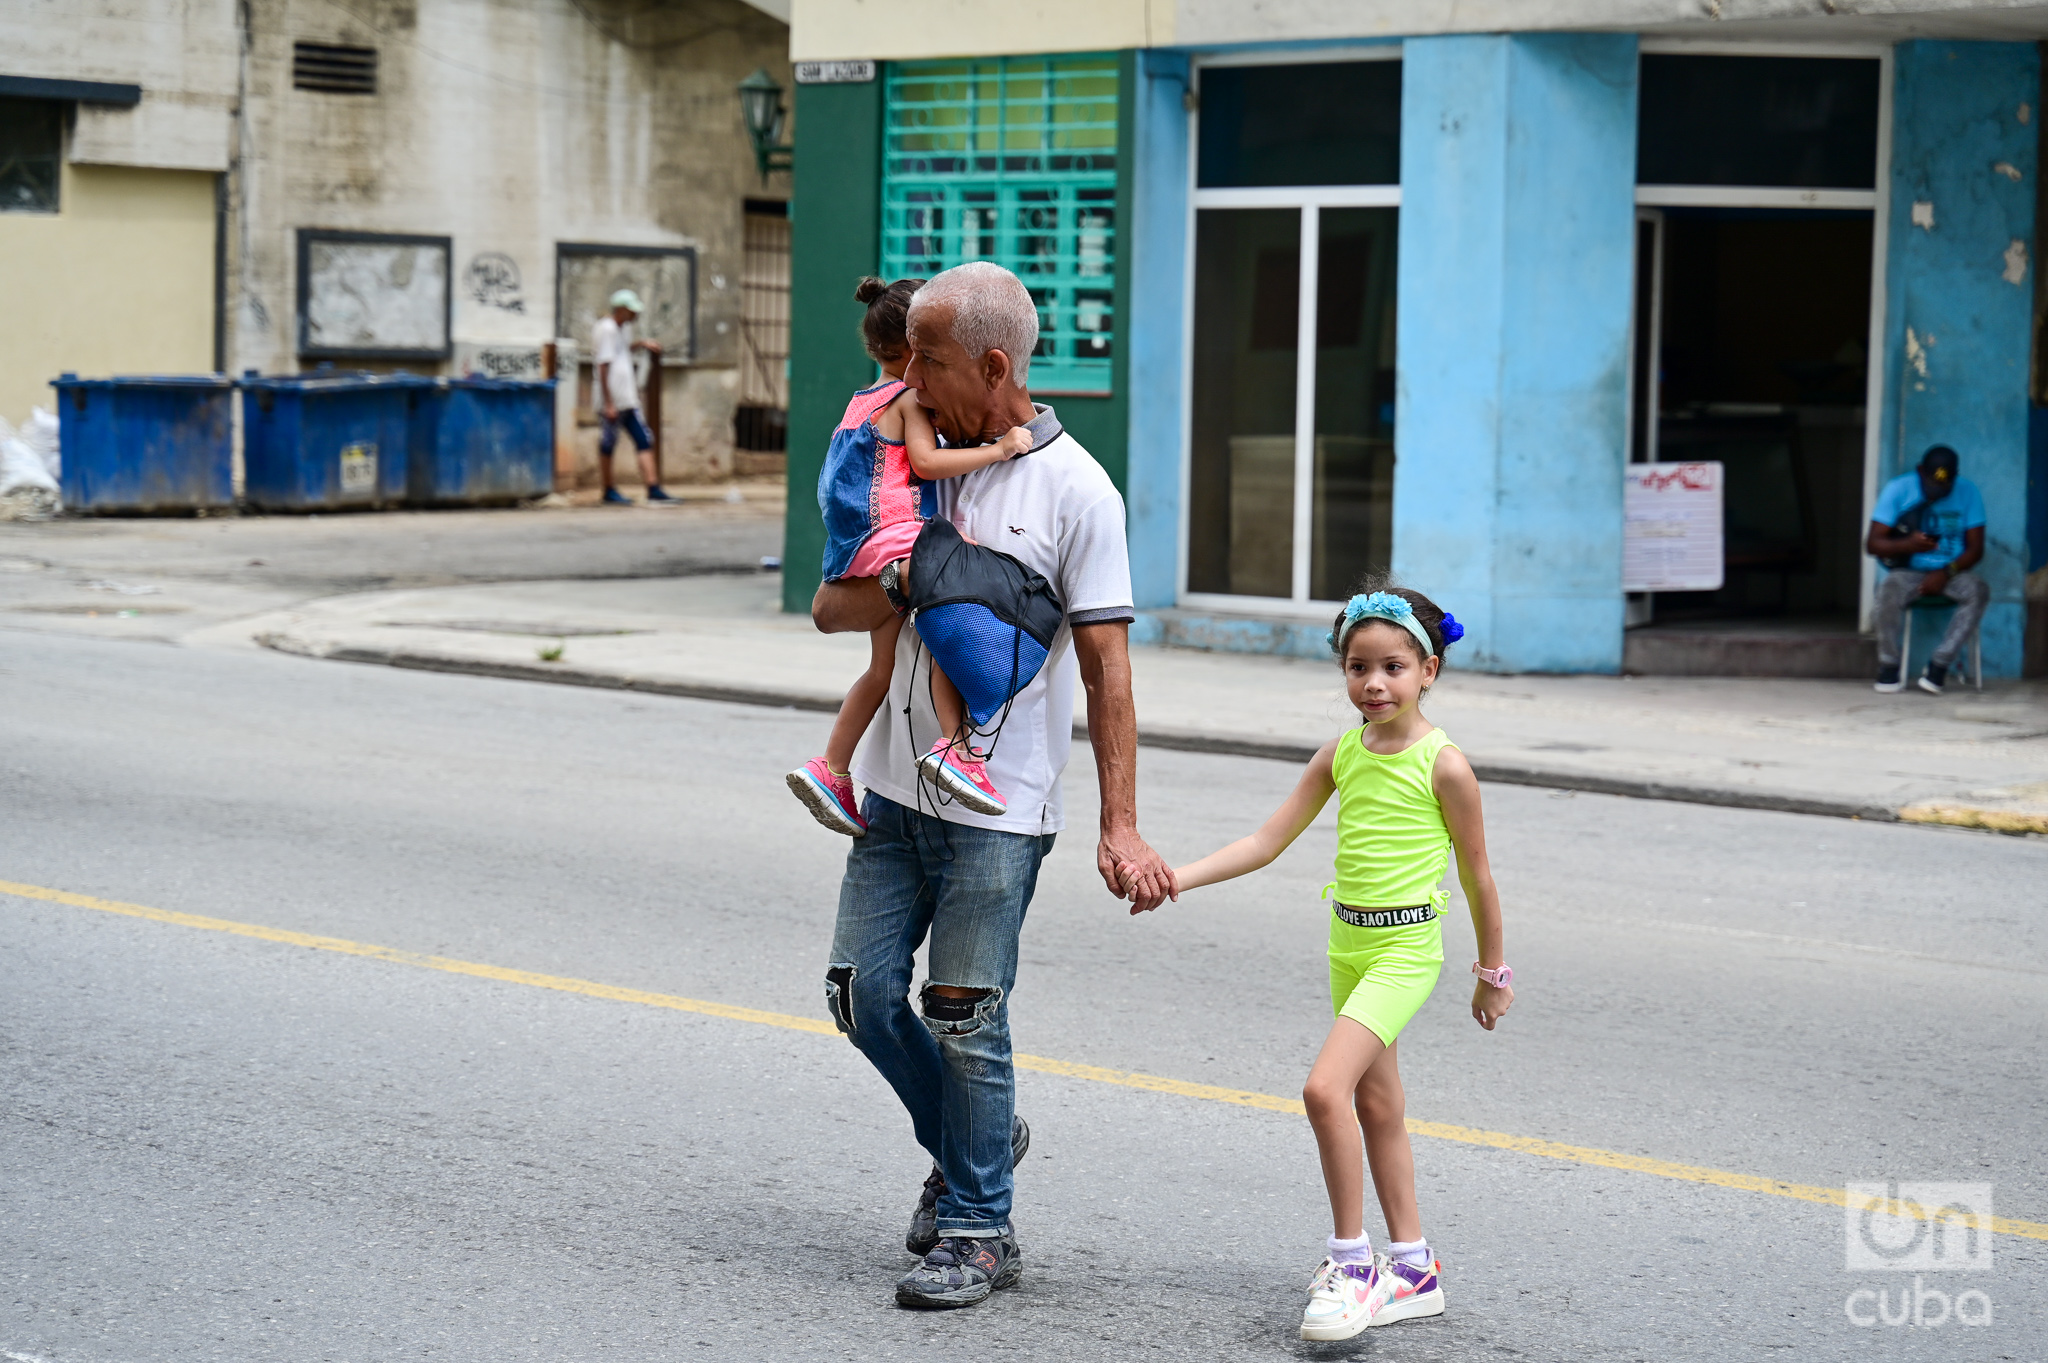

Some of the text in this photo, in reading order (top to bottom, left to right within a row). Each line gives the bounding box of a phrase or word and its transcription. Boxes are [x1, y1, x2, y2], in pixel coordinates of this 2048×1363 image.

[1340, 905, 1360, 926] LOVE
[1361, 911, 1393, 927] LOVE
[1393, 907, 1425, 925] LOVE
